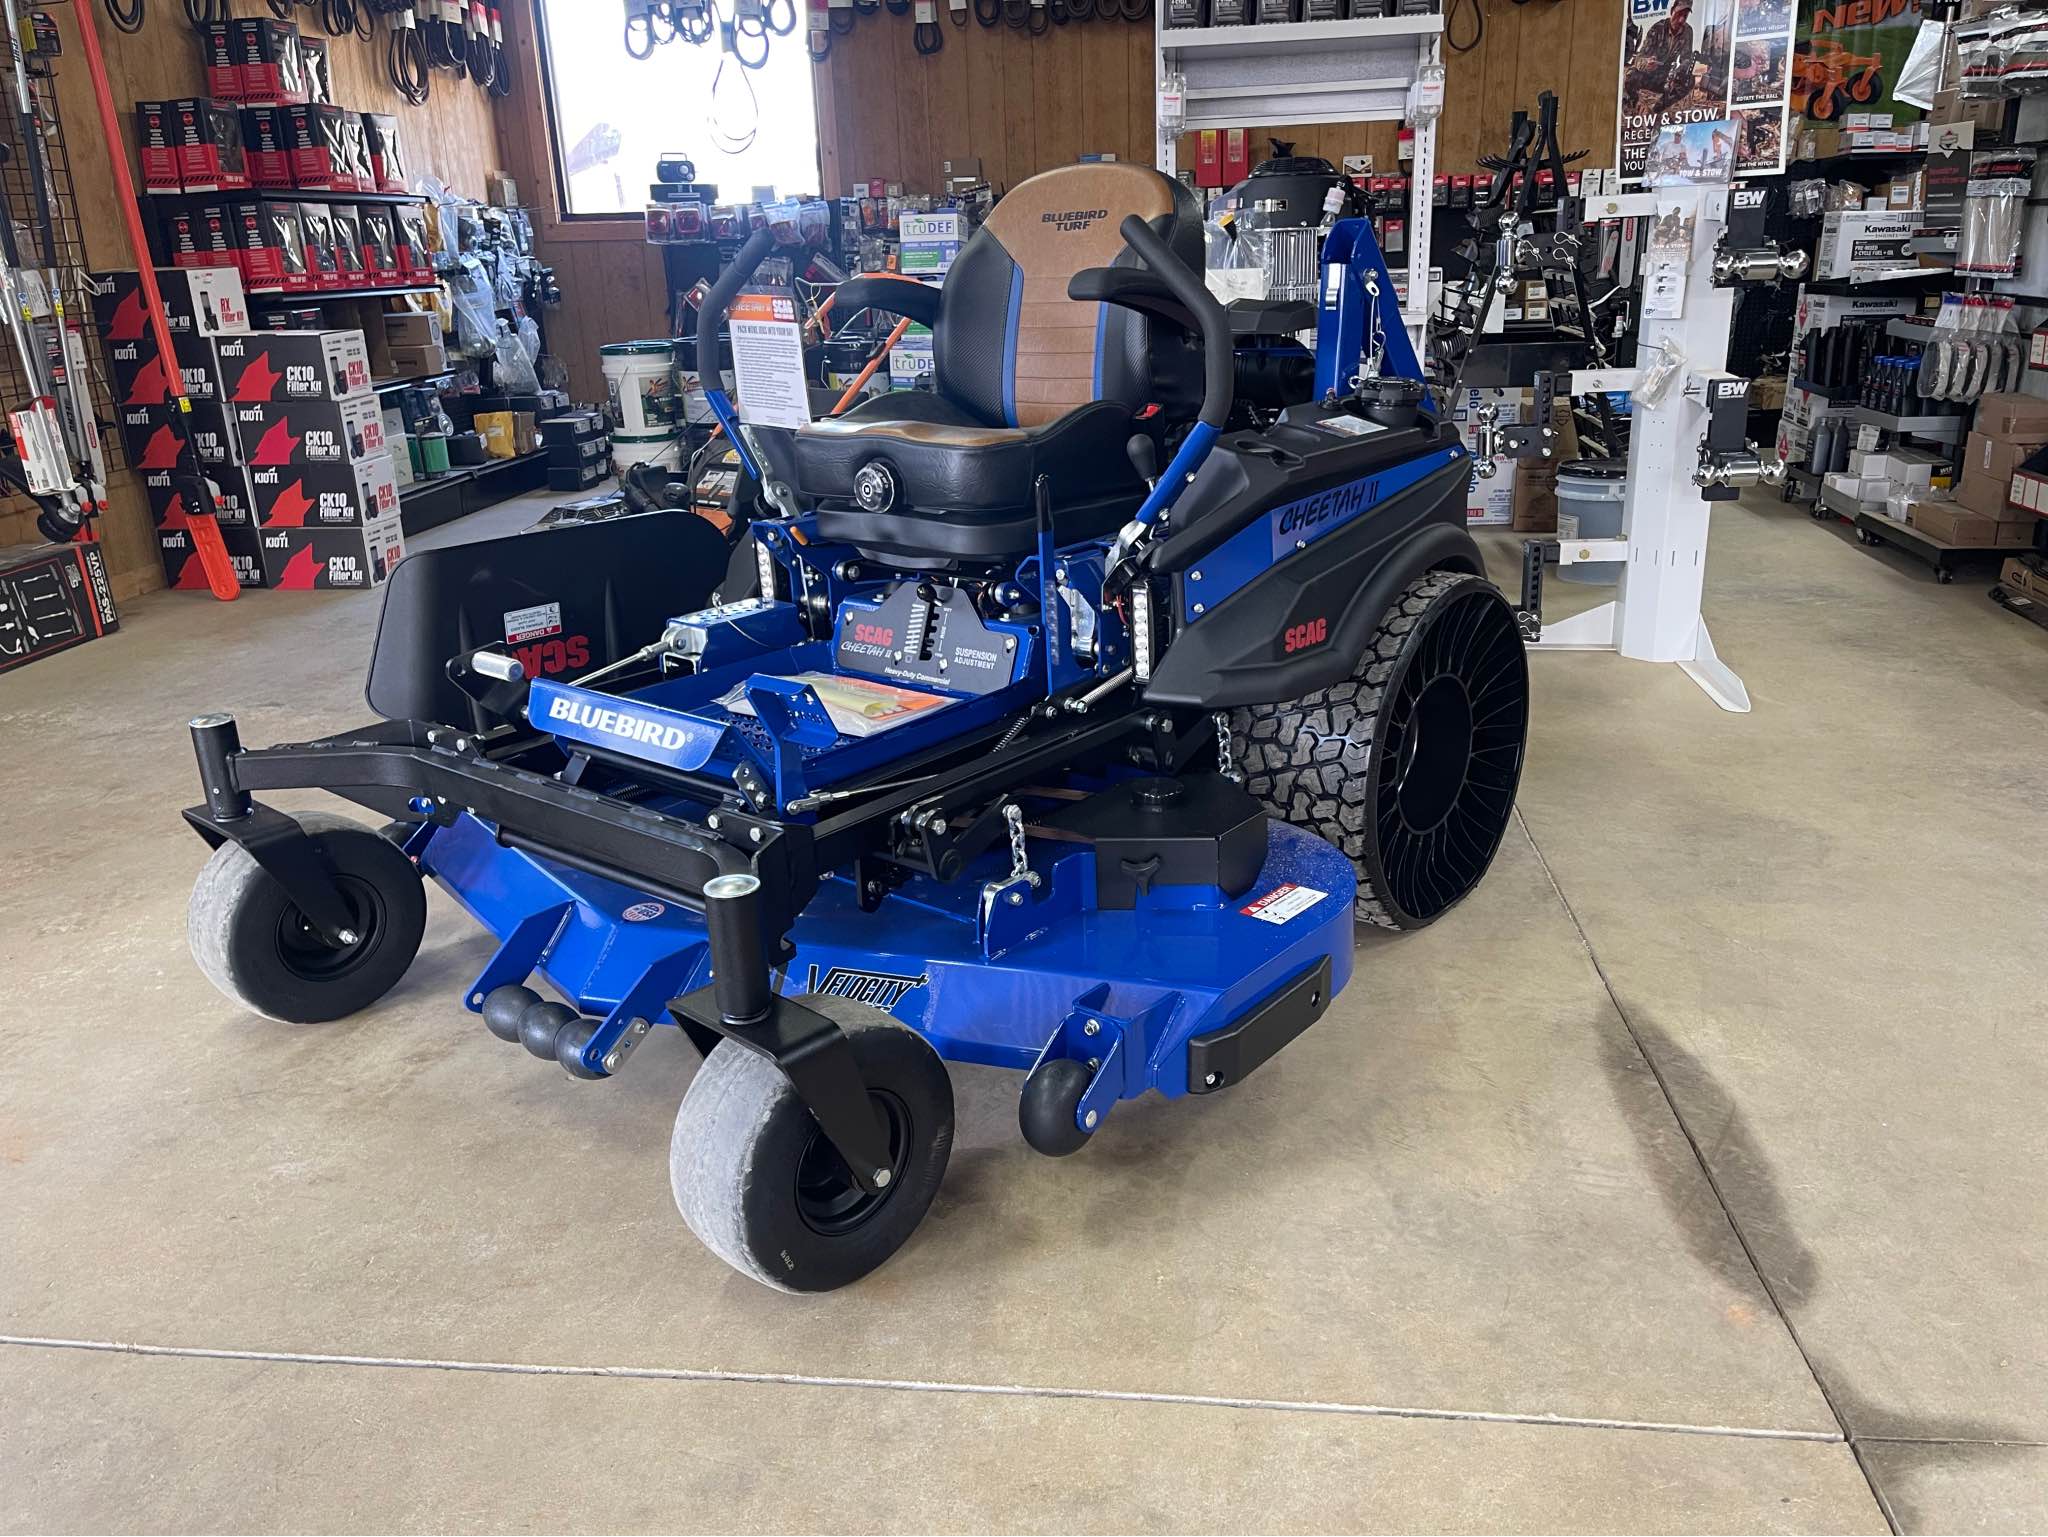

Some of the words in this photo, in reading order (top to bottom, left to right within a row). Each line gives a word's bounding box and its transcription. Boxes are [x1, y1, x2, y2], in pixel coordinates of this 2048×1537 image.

[1736, 94, 1755, 102] ROTATE
[1624, 113, 1657, 128] TOW
[1660, 112, 1670, 125] &
[1624, 129, 1651, 140] RECE
[1624, 148, 1646, 159] THE
[1679, 169, 1694, 177] TOW
[1695, 169, 1701, 177] &
[1734, 191, 1766, 205] BW
[1041, 209, 1108, 223] BLUEBIRD
[1056, 220, 1091, 231] TURF
[1864, 224, 1911, 233] Kawasaki
[220, 298, 231, 312] RX
[772, 299, 794, 313] SCAG
[1852, 300, 1897, 308] Kawasaki
[179, 316, 190, 327] Kit
[222, 313, 236, 323] Filter
[236, 311, 244, 321] Kit
[115, 346, 137, 360] KIOTI
[221, 342, 244, 357] KIOTI
[286, 366, 314, 381] CK10
[347, 361, 363, 376] CK10
[184, 383, 200, 393] ilter
[202, 382, 213, 393] Kit
[287, 381, 309, 391] Filter
[311, 381, 321, 391] Kit
[349, 376, 361, 386] Filter
[1718, 381, 1749, 395] BW
[1469, 389, 1482, 409] elo
[126, 410, 149, 424] KIOTI
[240, 407, 263, 421] KIOTI
[363, 423, 378, 438] CK10
[195, 433, 217, 447] K10
[305, 431, 333, 445] CK10
[213, 447, 224, 457] Kit
[305, 446, 327, 456] Filter
[329, 445, 340, 456] Kit
[148, 473, 170, 486] KIOTI
[254, 470, 278, 483] KIOTI
[378, 483, 392, 498] CK10
[319, 493, 347, 507] CK10
[235, 508, 245, 518] Kit
[319, 507, 341, 517] Filter
[343, 507, 354, 517] Kit
[1279, 482, 1366, 535] CHEETAH
[1369, 481, 1379, 502] II
[162, 534, 185, 548] KIOTI
[265, 534, 288, 548] KIOTI
[329, 557, 355, 571] CK10
[249, 569, 260, 579] Kit
[329, 571, 350, 581] Filter
[352, 571, 362, 580] Kit
[90, 552, 114, 624] PAS-225VP
[516, 629, 545, 640] DANGER
[854, 624, 893, 646] SCAG
[1285, 618, 1326, 652] SCAG
[841, 640, 887, 657] CHEETAH
[885, 648, 892, 658] II
[955, 647, 997, 662] SUSPENSION
[512, 635, 589, 679] SCA
[954, 657, 995, 671] ADJUSTMENT
[884, 667, 916, 679] Heavy-Duty
[916, 673, 950, 685] Commercial
[1257, 886, 1294, 906] DANGER
